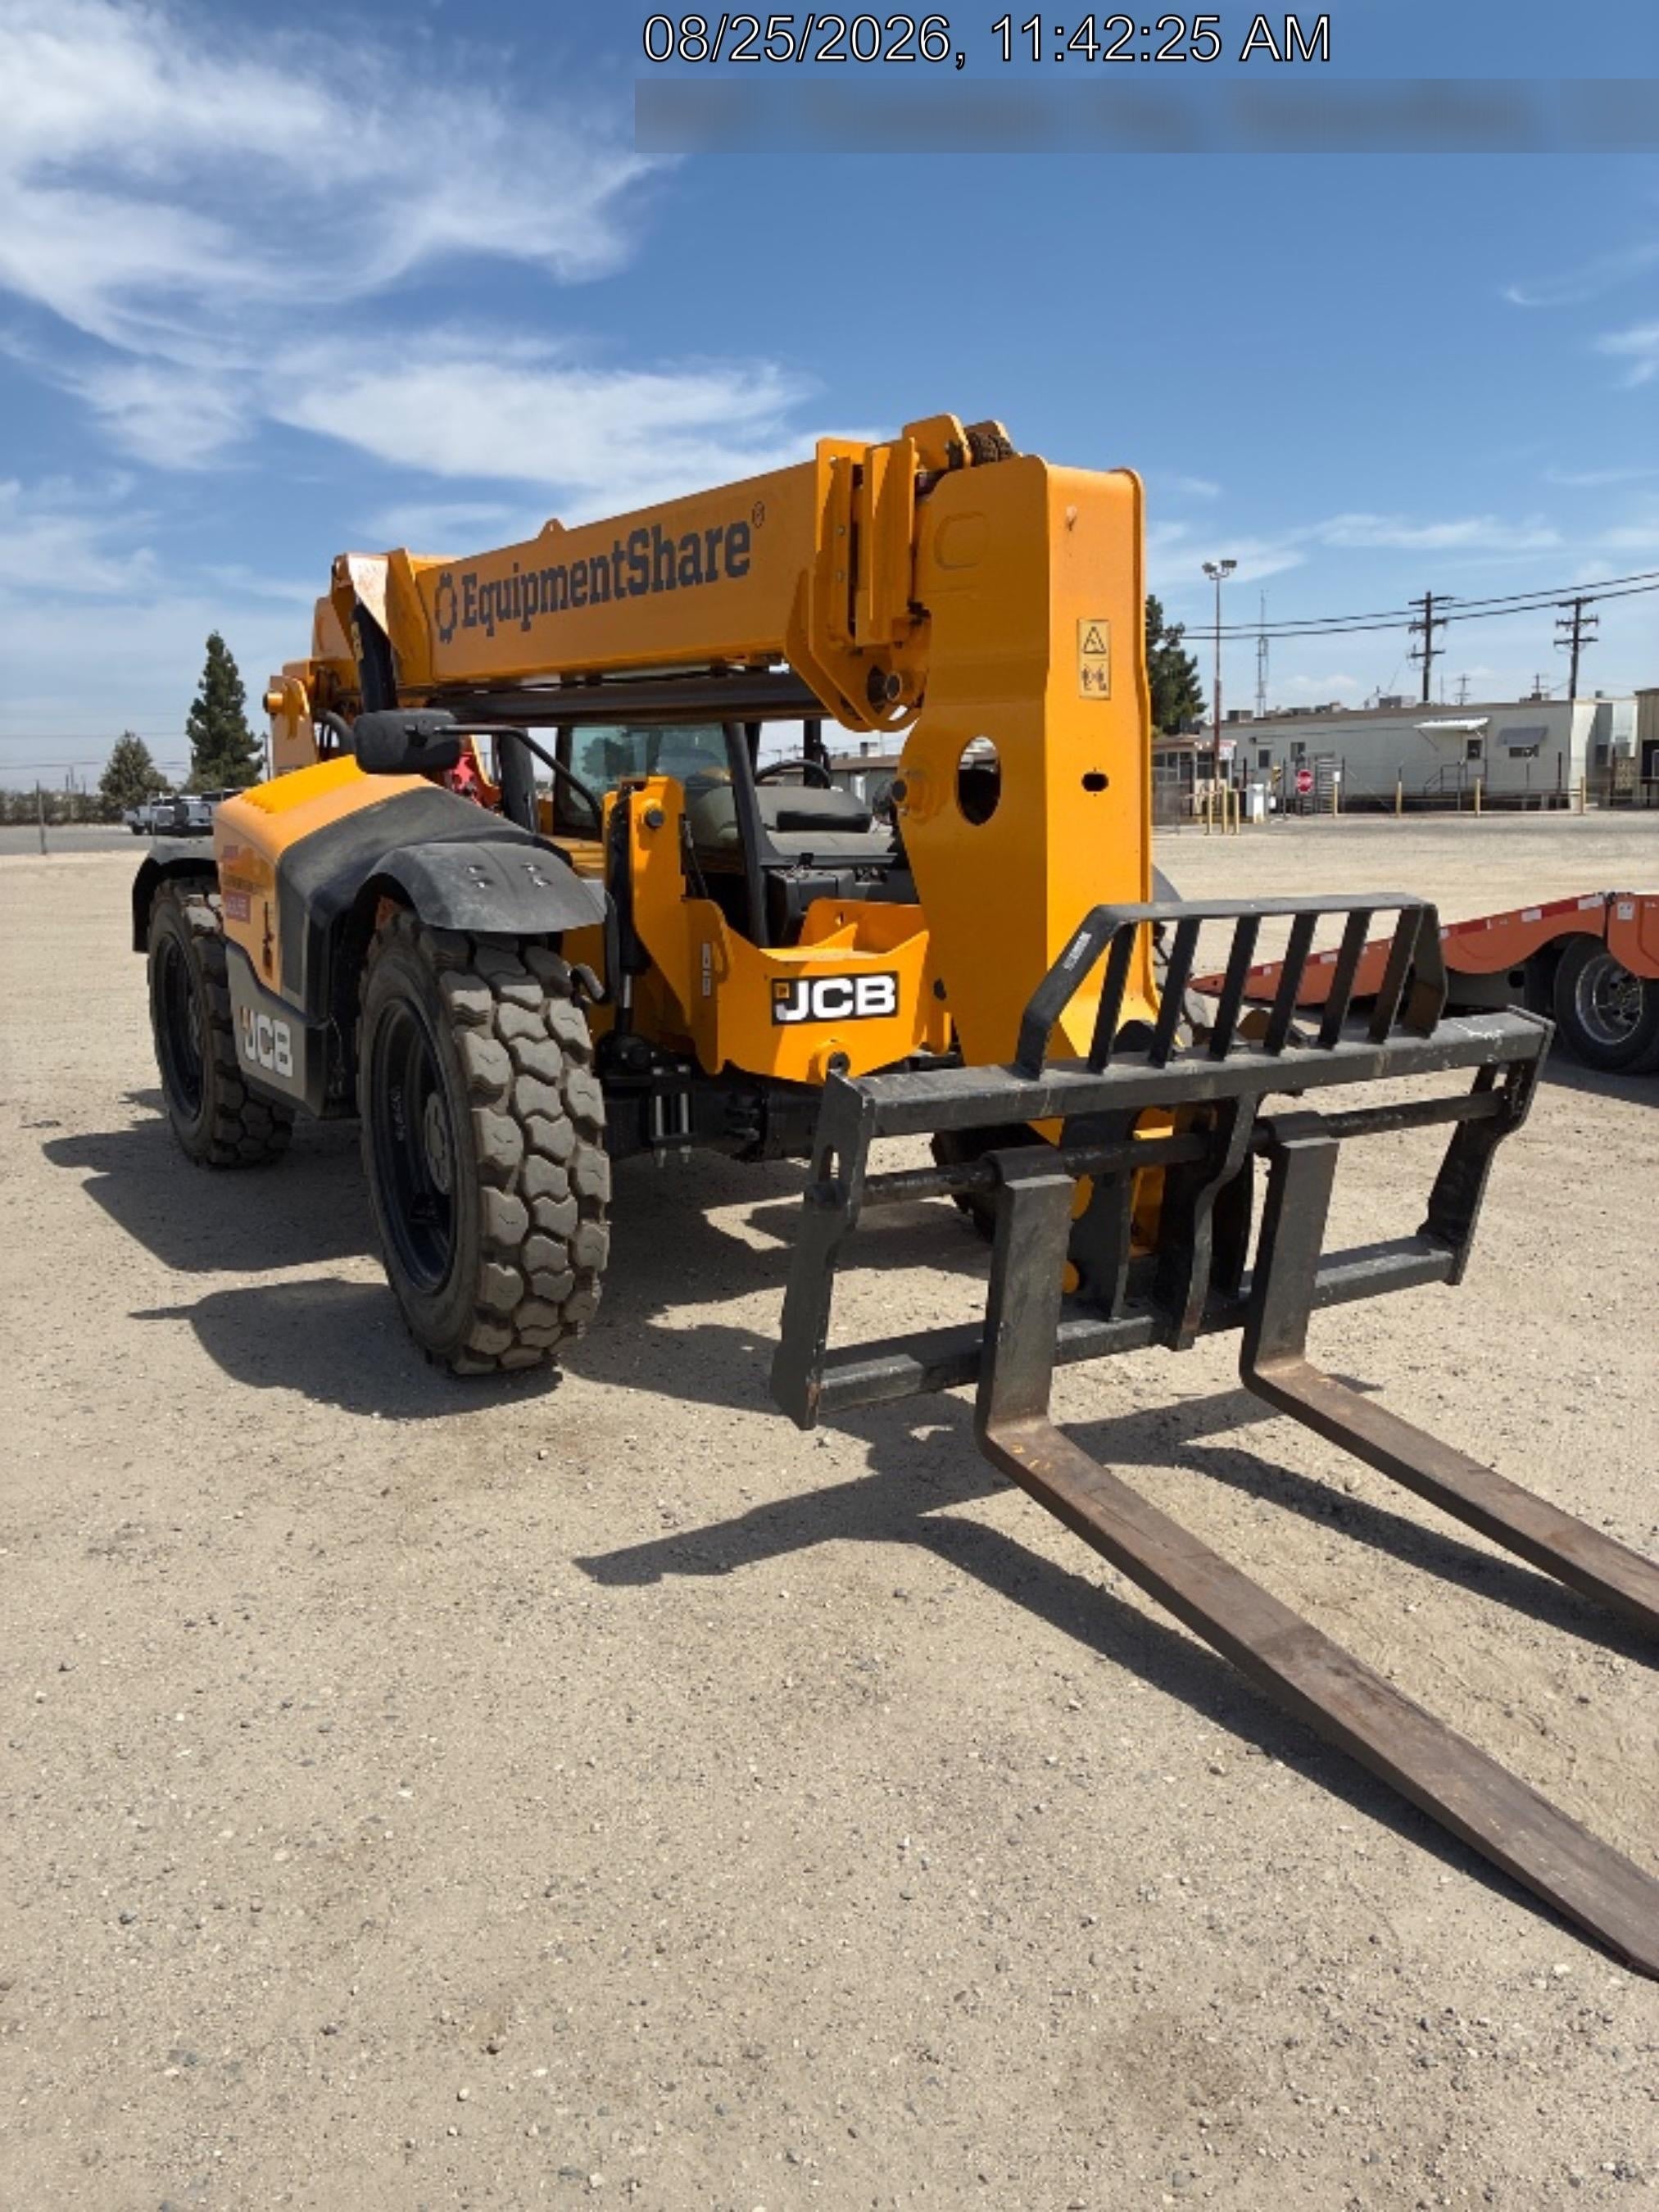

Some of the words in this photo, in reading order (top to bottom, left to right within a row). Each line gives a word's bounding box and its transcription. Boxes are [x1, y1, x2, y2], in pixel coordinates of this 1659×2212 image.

[461, 521, 751, 637] EquipmentShare
[774, 975, 896, 1022] JCB
[243, 1007, 293, 1077] JCB
